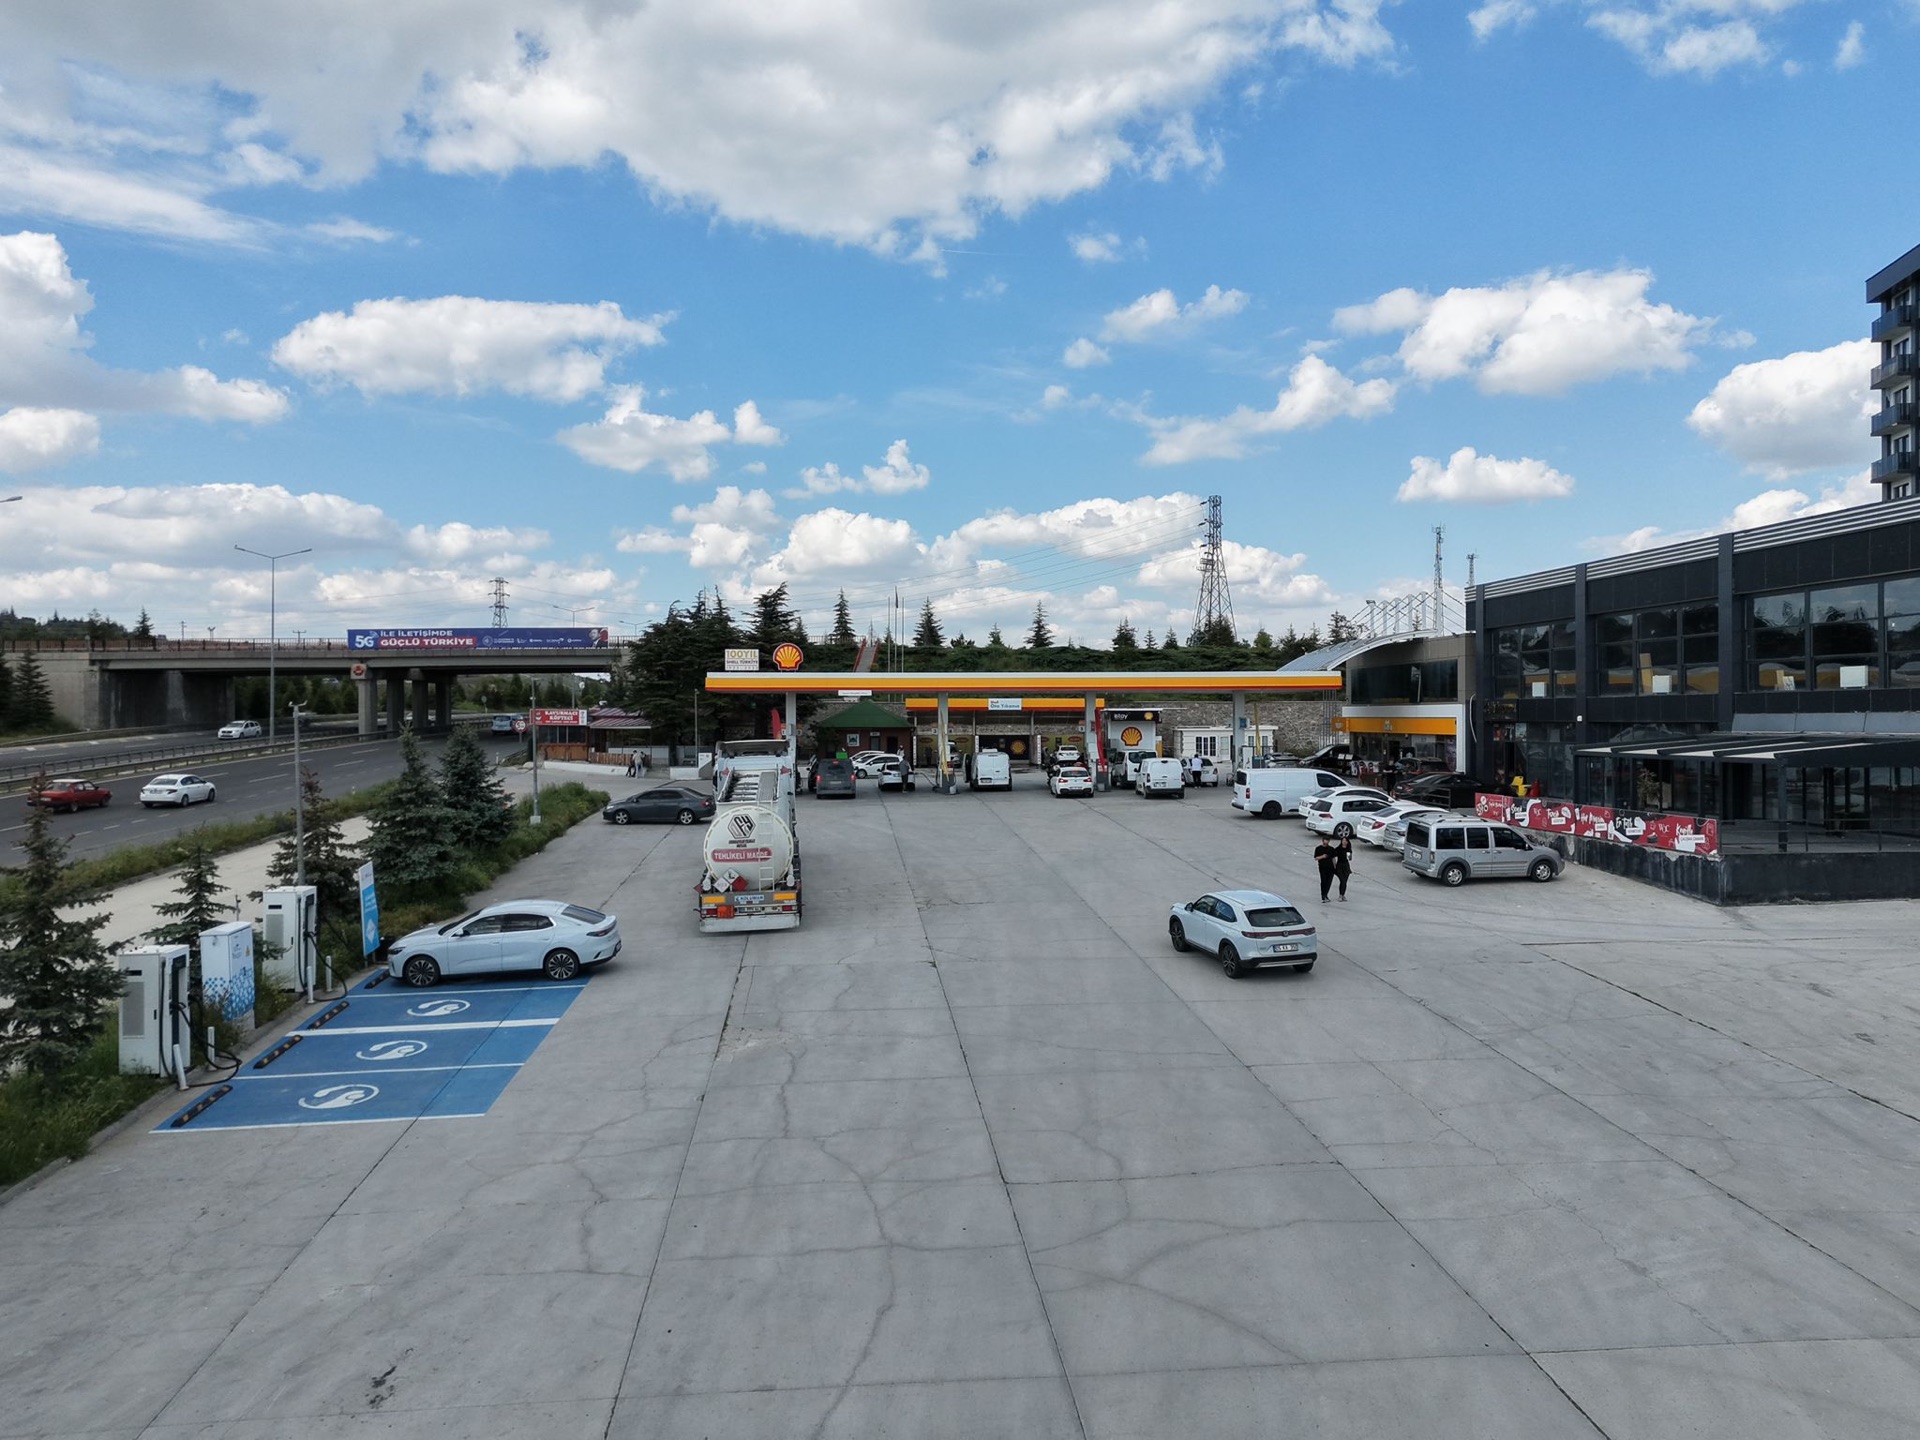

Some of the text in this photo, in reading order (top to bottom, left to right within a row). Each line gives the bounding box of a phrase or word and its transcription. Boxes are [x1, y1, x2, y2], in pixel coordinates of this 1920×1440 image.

[398, 630, 453, 638] İLETİŞİMDE
[355, 635, 374, 648] 5G
[380, 637, 420, 647] GÜÇLÜ
[423, 637, 474, 646] TÜRKİYE
[714, 851, 745, 860] TEHLİKELİ
